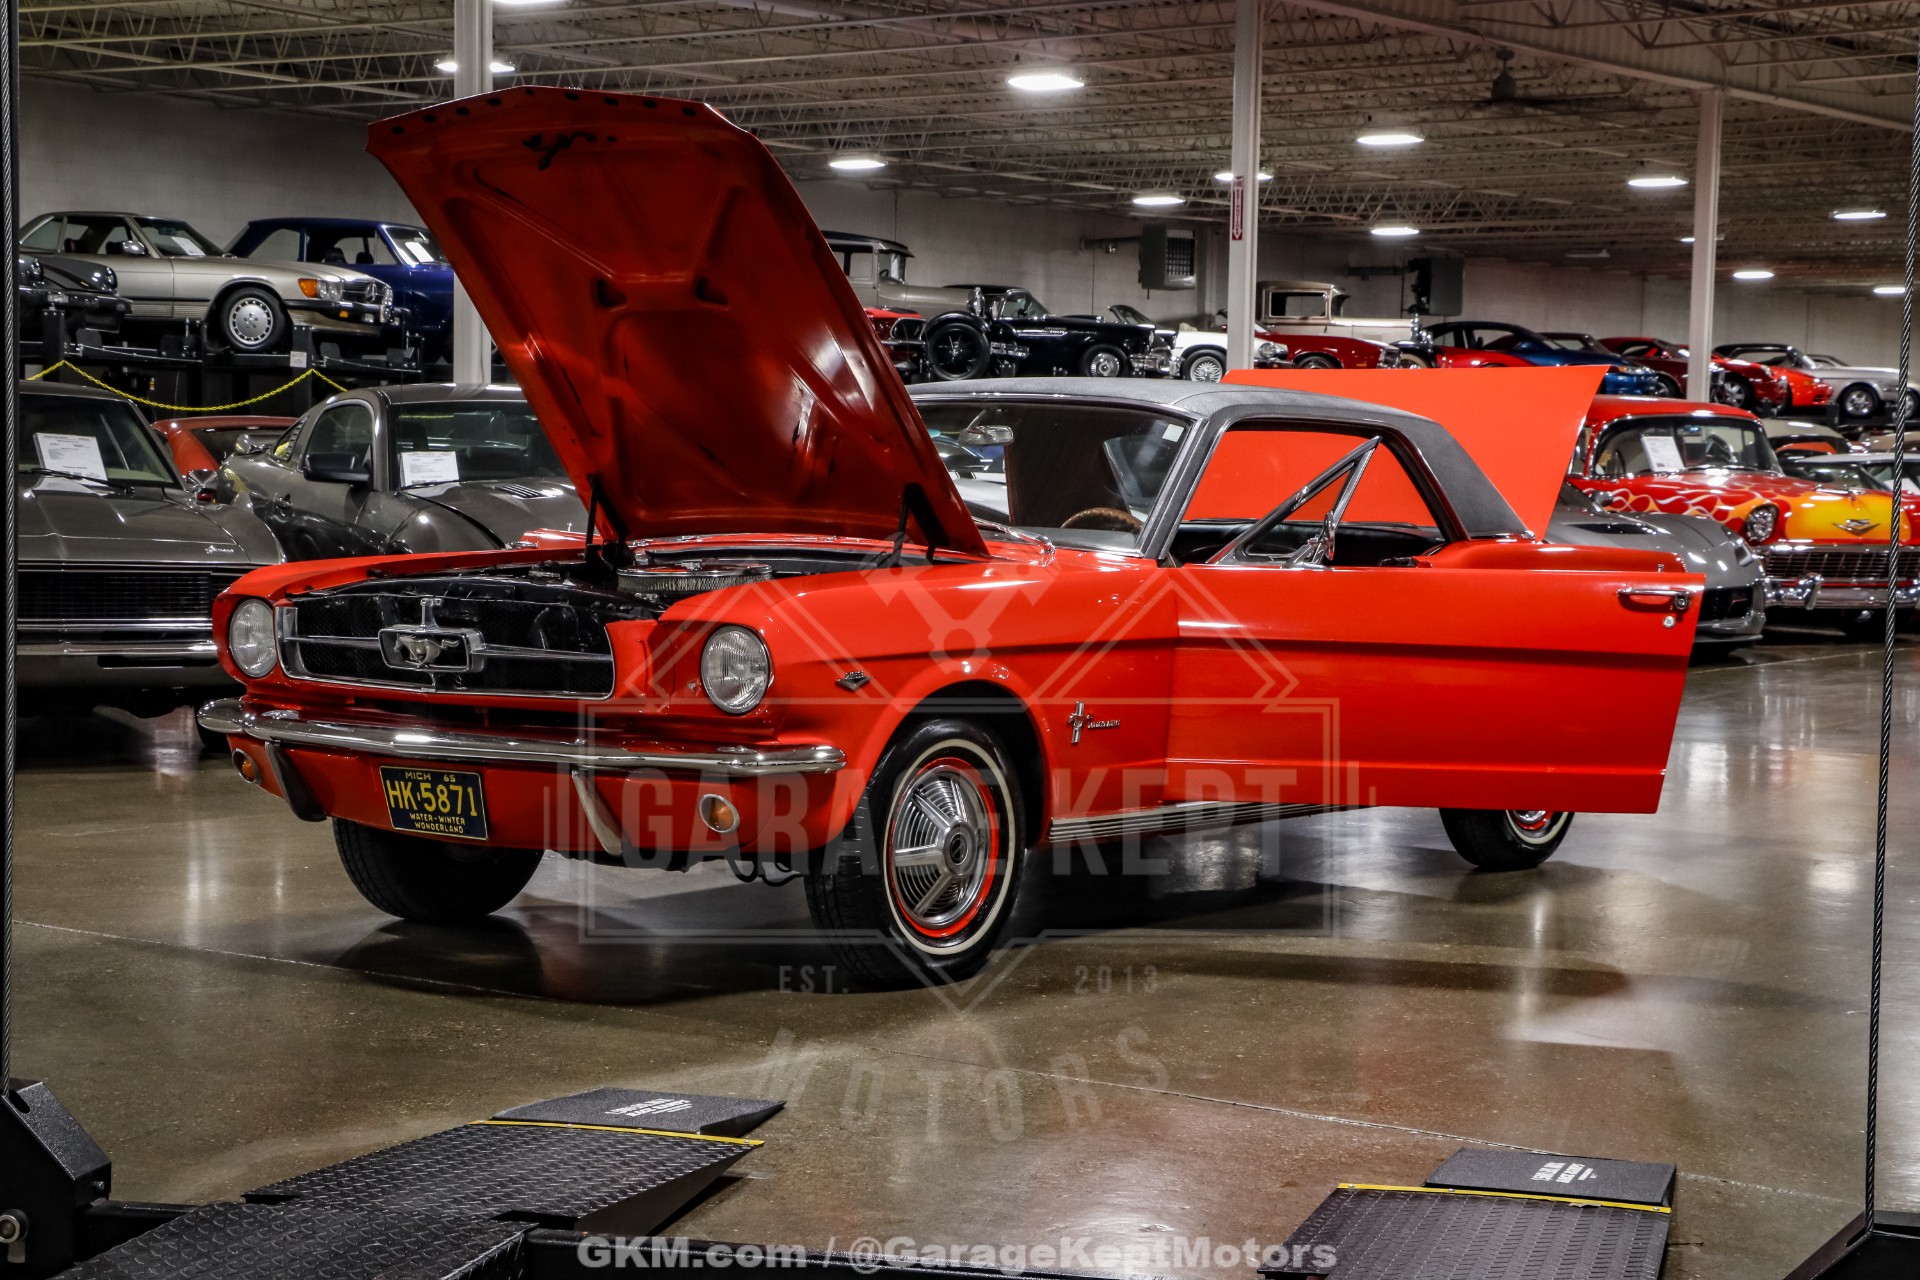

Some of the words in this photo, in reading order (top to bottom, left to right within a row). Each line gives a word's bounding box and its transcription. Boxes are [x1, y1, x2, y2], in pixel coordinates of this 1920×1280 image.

[405, 771, 432, 781] MICH
[443, 774, 456, 783] 65
[414, 821, 464, 834] WONDERLAND
